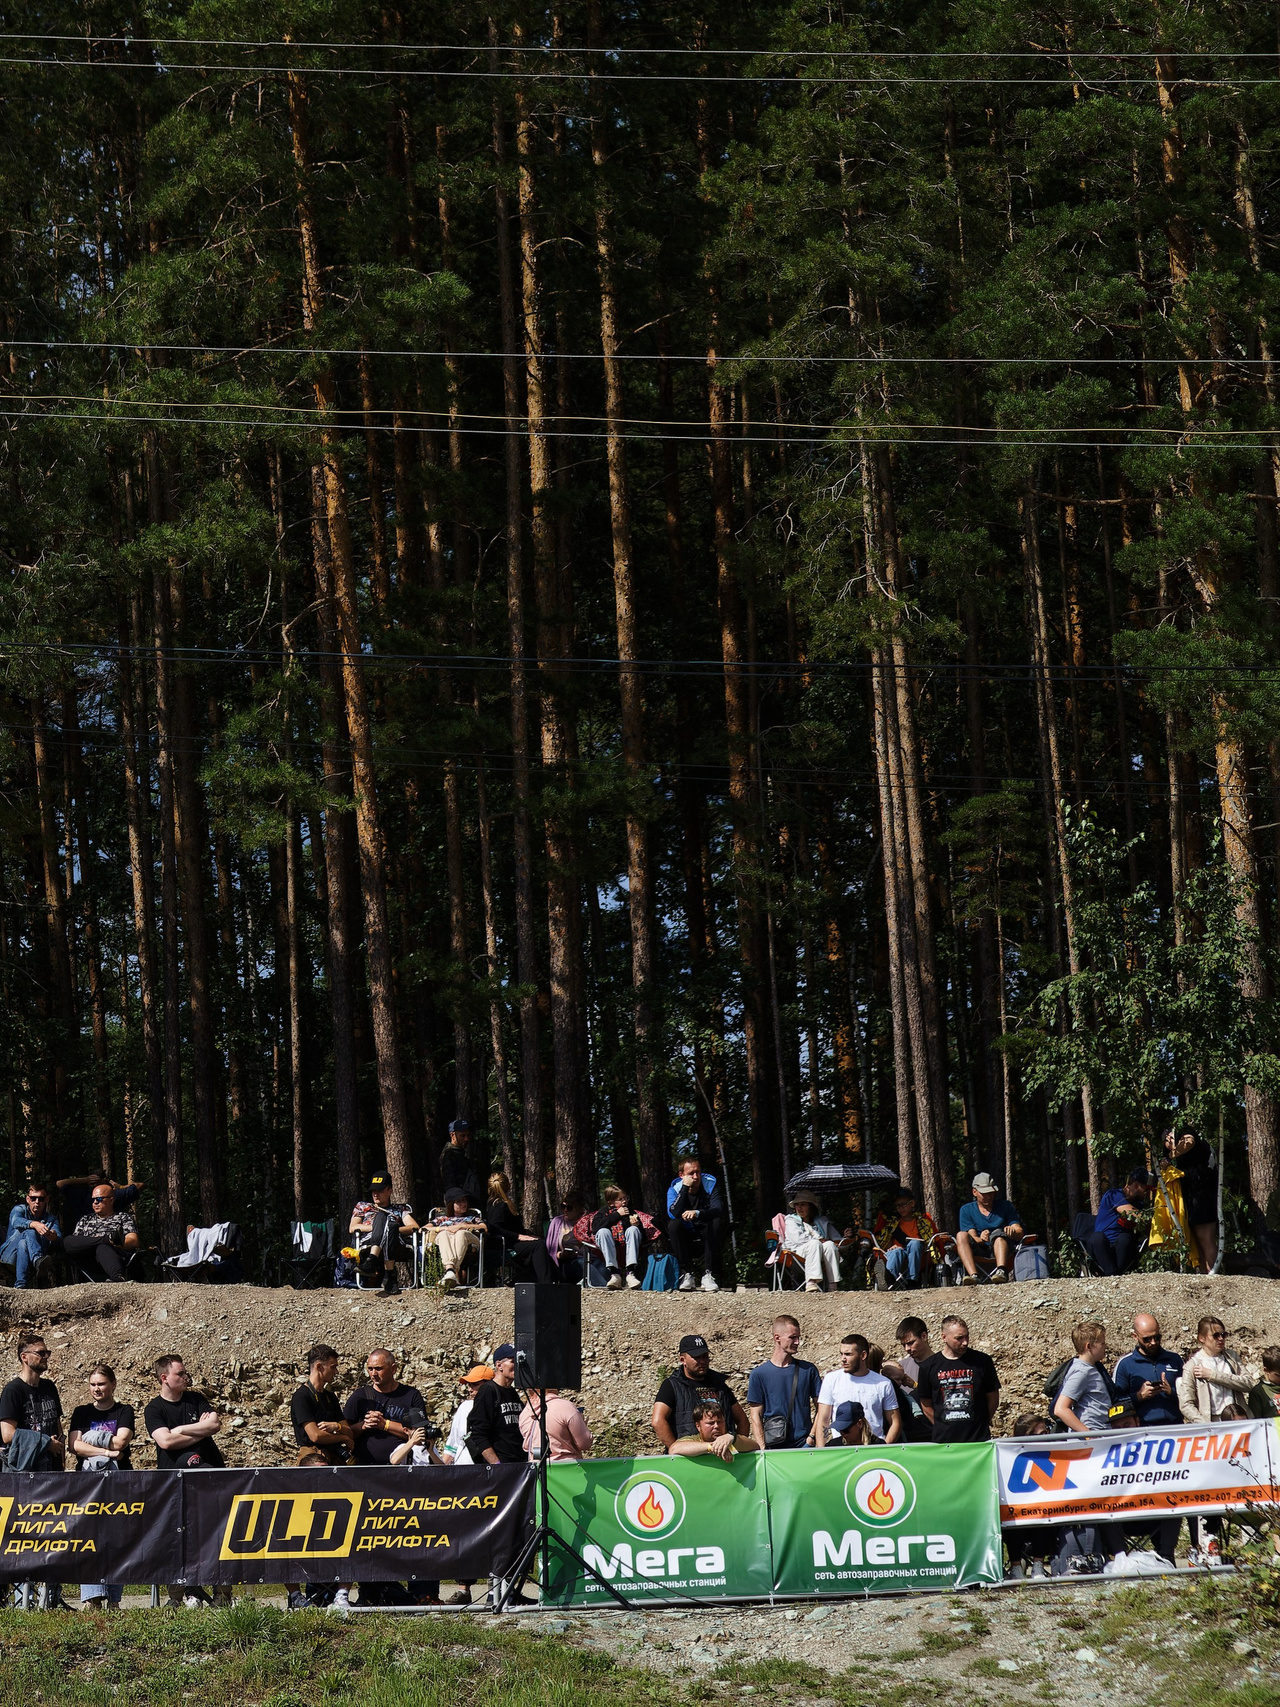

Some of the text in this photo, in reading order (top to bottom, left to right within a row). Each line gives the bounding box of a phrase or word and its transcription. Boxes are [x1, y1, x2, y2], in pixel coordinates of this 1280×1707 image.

[1101, 1432, 1251, 1469] АВТОТЕМА
[1100, 1469, 1190, 1486] автосервис
[17, 1502, 145, 1517] УРАЛЬСКАЯ
[367, 1495, 498, 1512] УРАЛЬСКАЯ
[1021, 1505, 1087, 1517] Екатеринбург,
[1089, 1501, 1137, 1512] Фигурная,
[10, 1520, 67, 1534] ЛИГА
[228, 1497, 353, 1554] ULD
[361, 1515, 420, 1530] ЛИГА
[4, 1539, 96, 1556] ДРИФТА
[356, 1534, 451, 1552] ДРИФТА
[812, 1529, 956, 1567] Мега
[582, 1543, 726, 1580] Мега
[814, 1564, 957, 1580] сеть автозаправочных станций
[585, 1575, 727, 1592] сеть втозаправочных станций
